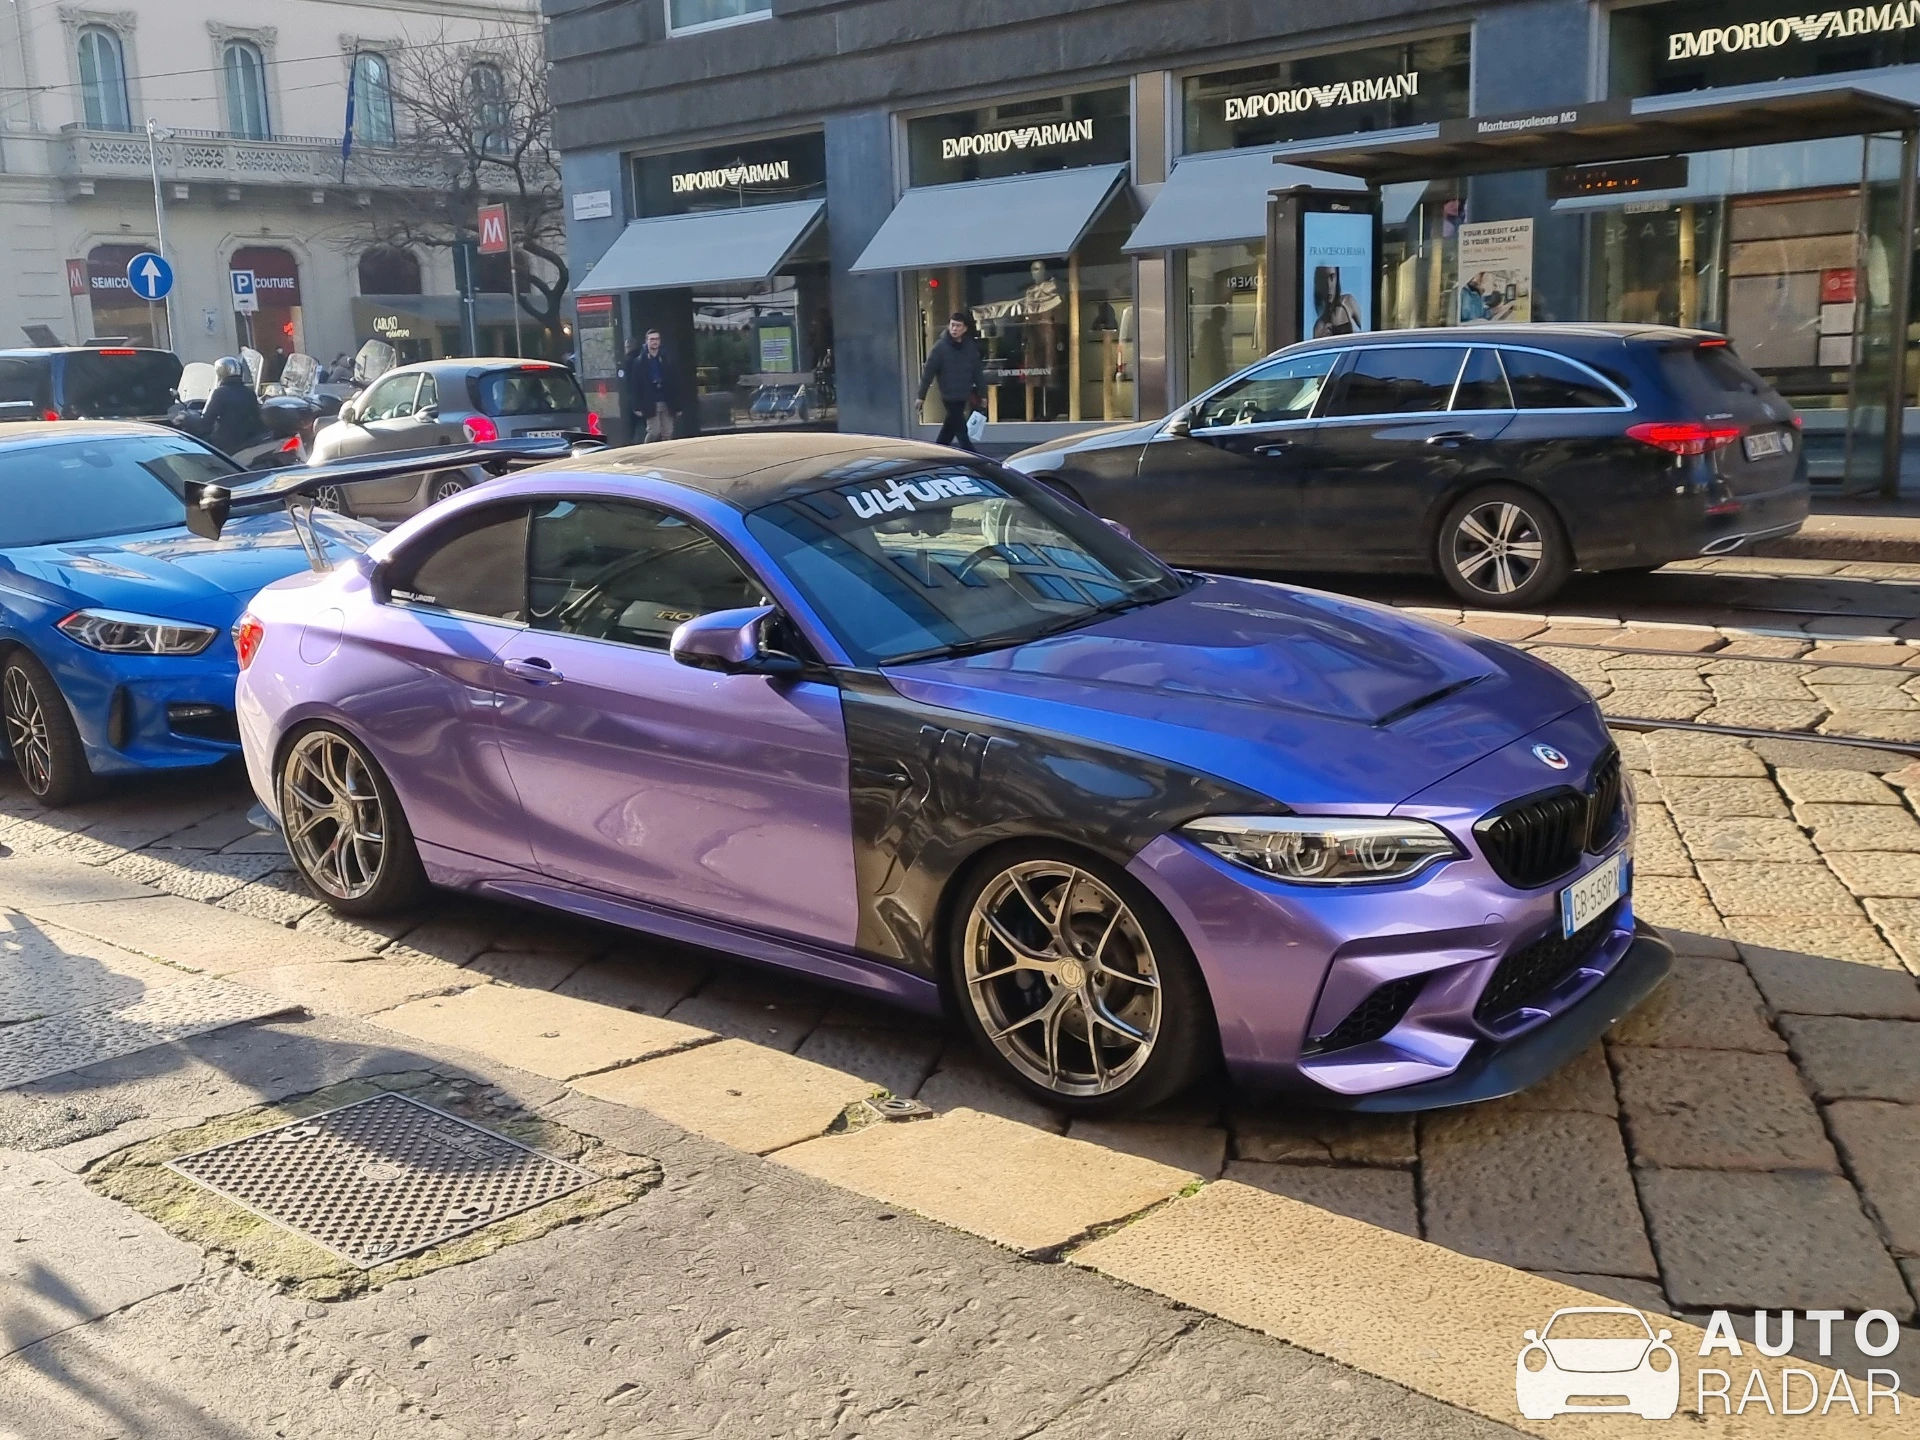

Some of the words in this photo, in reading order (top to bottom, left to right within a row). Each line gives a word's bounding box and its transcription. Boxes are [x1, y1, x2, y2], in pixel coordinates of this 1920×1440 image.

[1668, 18, 1791, 60] EMPORIO
[1224, 88, 1312, 121] EMPORIO
[1338, 72, 1418, 106] ARMANI
[1478, 115, 1558, 133] Montenapoleone
[1561, 111, 1577, 123] M3
[942, 131, 1011, 159] EMPORIO
[1031, 119, 1093, 146] ARMANI
[672, 169, 726, 192] EMPORIO
[741, 160, 790, 184] ARMANI
[1483, 227, 1508, 236] CREDIT
[1510, 225, 1529, 233] CARD
[255, 277, 295, 288] COUTURE
